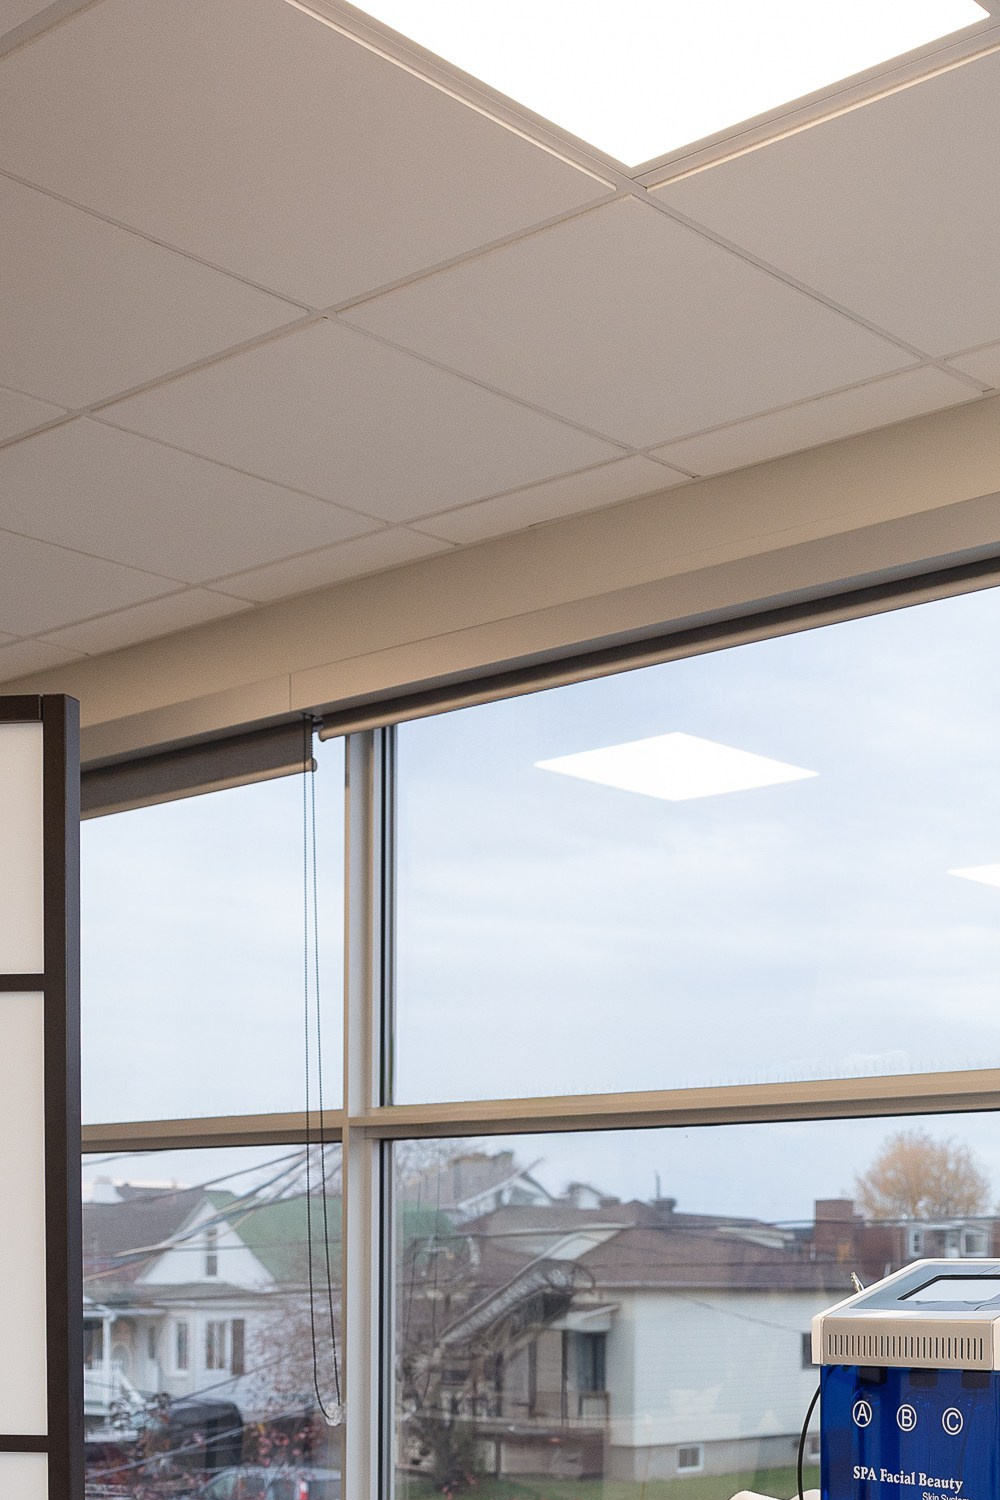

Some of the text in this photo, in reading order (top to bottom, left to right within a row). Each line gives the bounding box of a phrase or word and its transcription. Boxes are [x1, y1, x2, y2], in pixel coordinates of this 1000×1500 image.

[946, 1411, 960, 1431] C
[853, 1465, 964, 1494] SPA Facial Beauty
